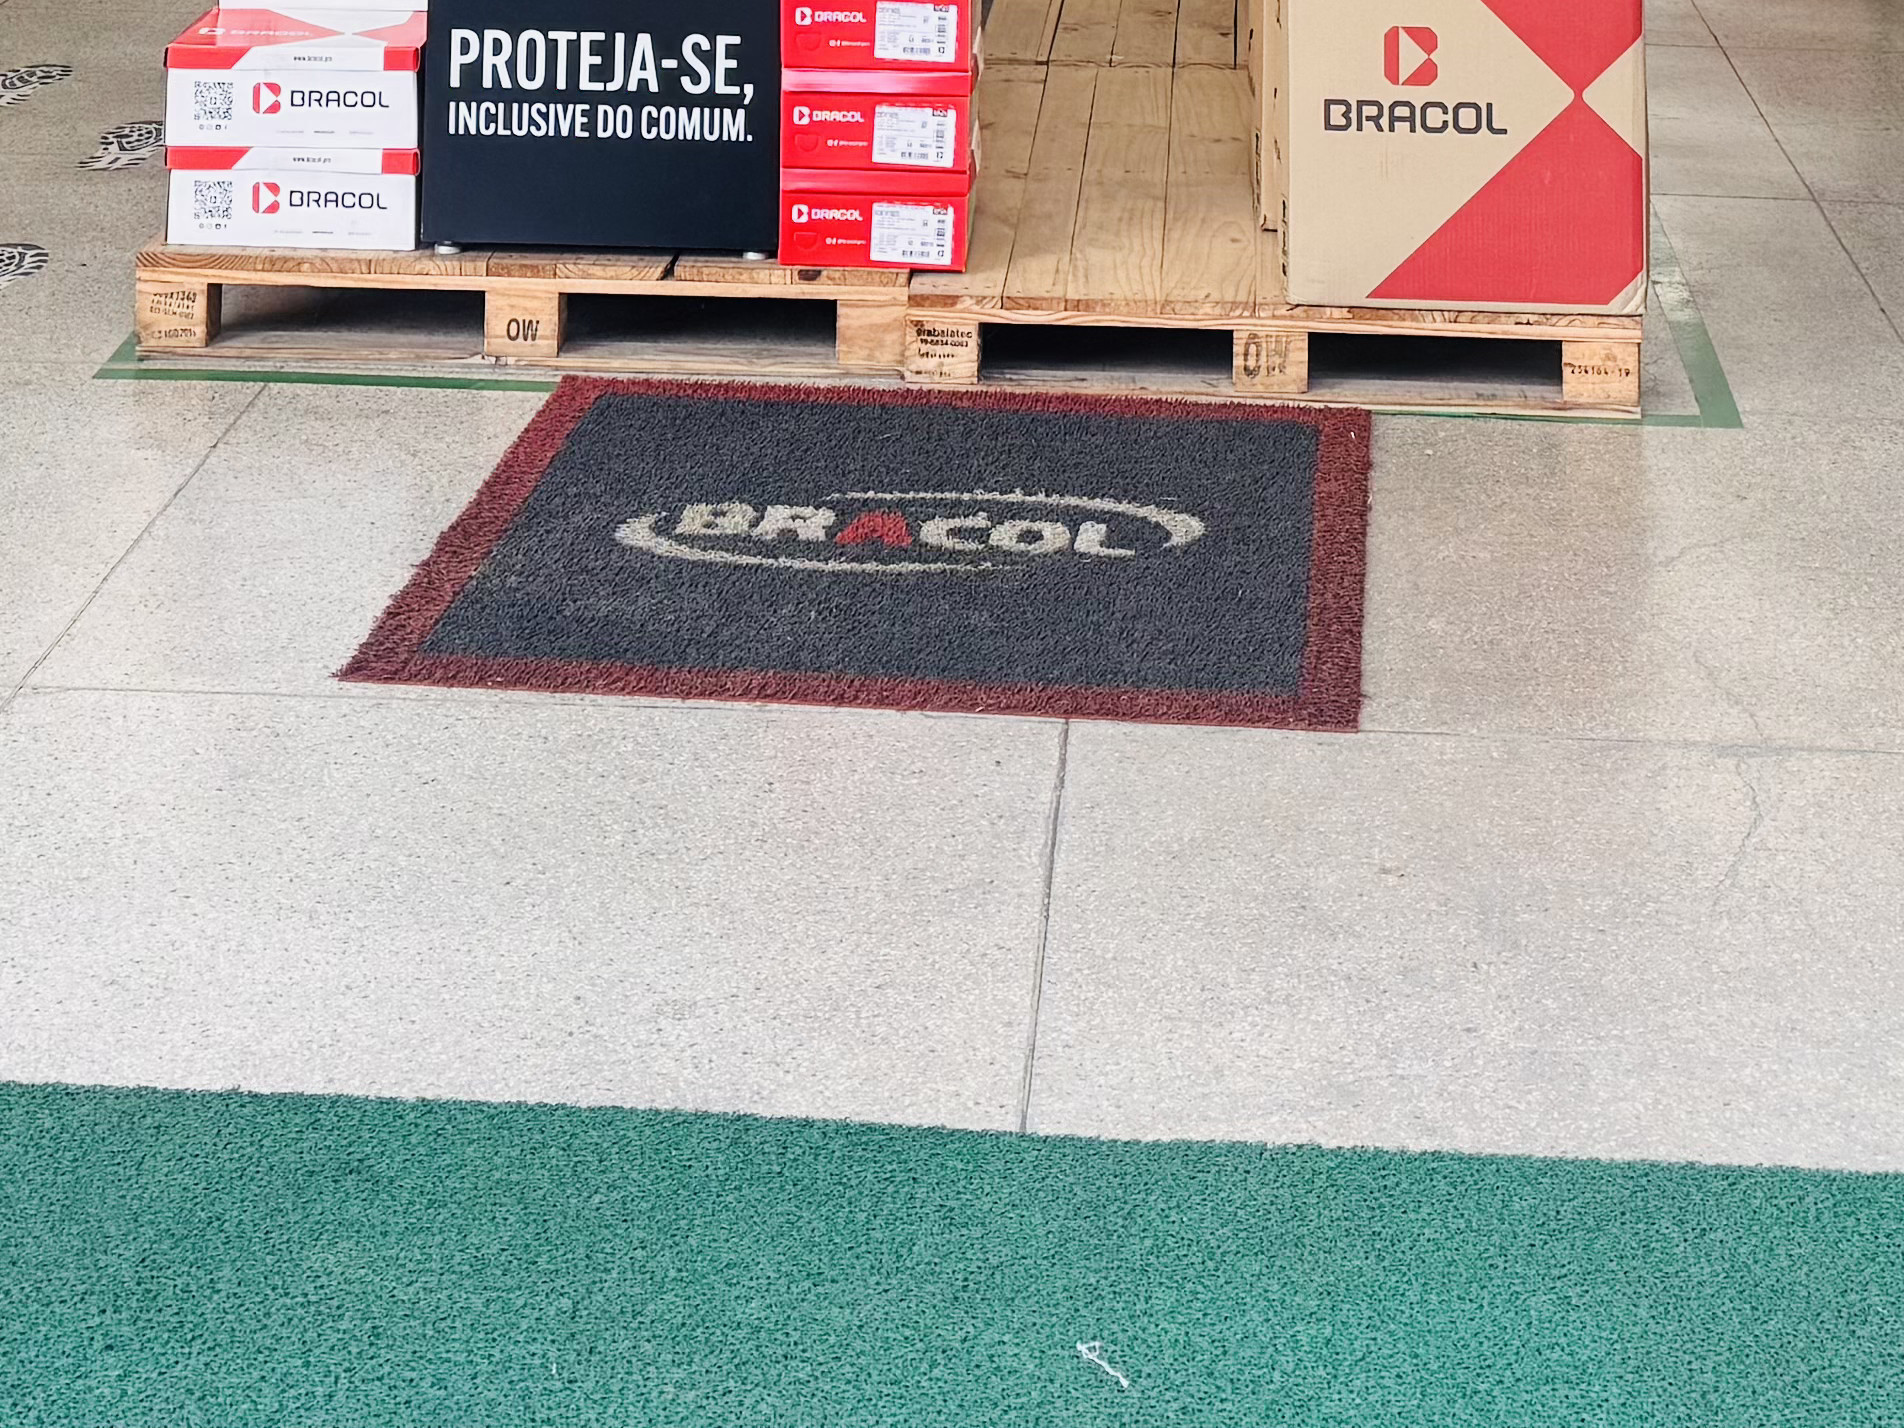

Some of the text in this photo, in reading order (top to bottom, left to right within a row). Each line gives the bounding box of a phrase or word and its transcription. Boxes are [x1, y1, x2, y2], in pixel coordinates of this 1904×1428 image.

[813, 10, 867, 23] BRACOL
[447, 27, 756, 107] PROTEJA-SE,
[289, 90, 390, 109] BRACOL
[447, 101, 755, 144] INCLUSIVE DO COMUM.
[812, 110, 865, 123] BRACOL
[1322, 98, 1508, 136] BRACOL
[289, 190, 388, 210] BRACOL
[811, 209, 863, 221] BRACOL
[506, 317, 540, 342] OW
[674, 500, 1136, 558] BRACOL
